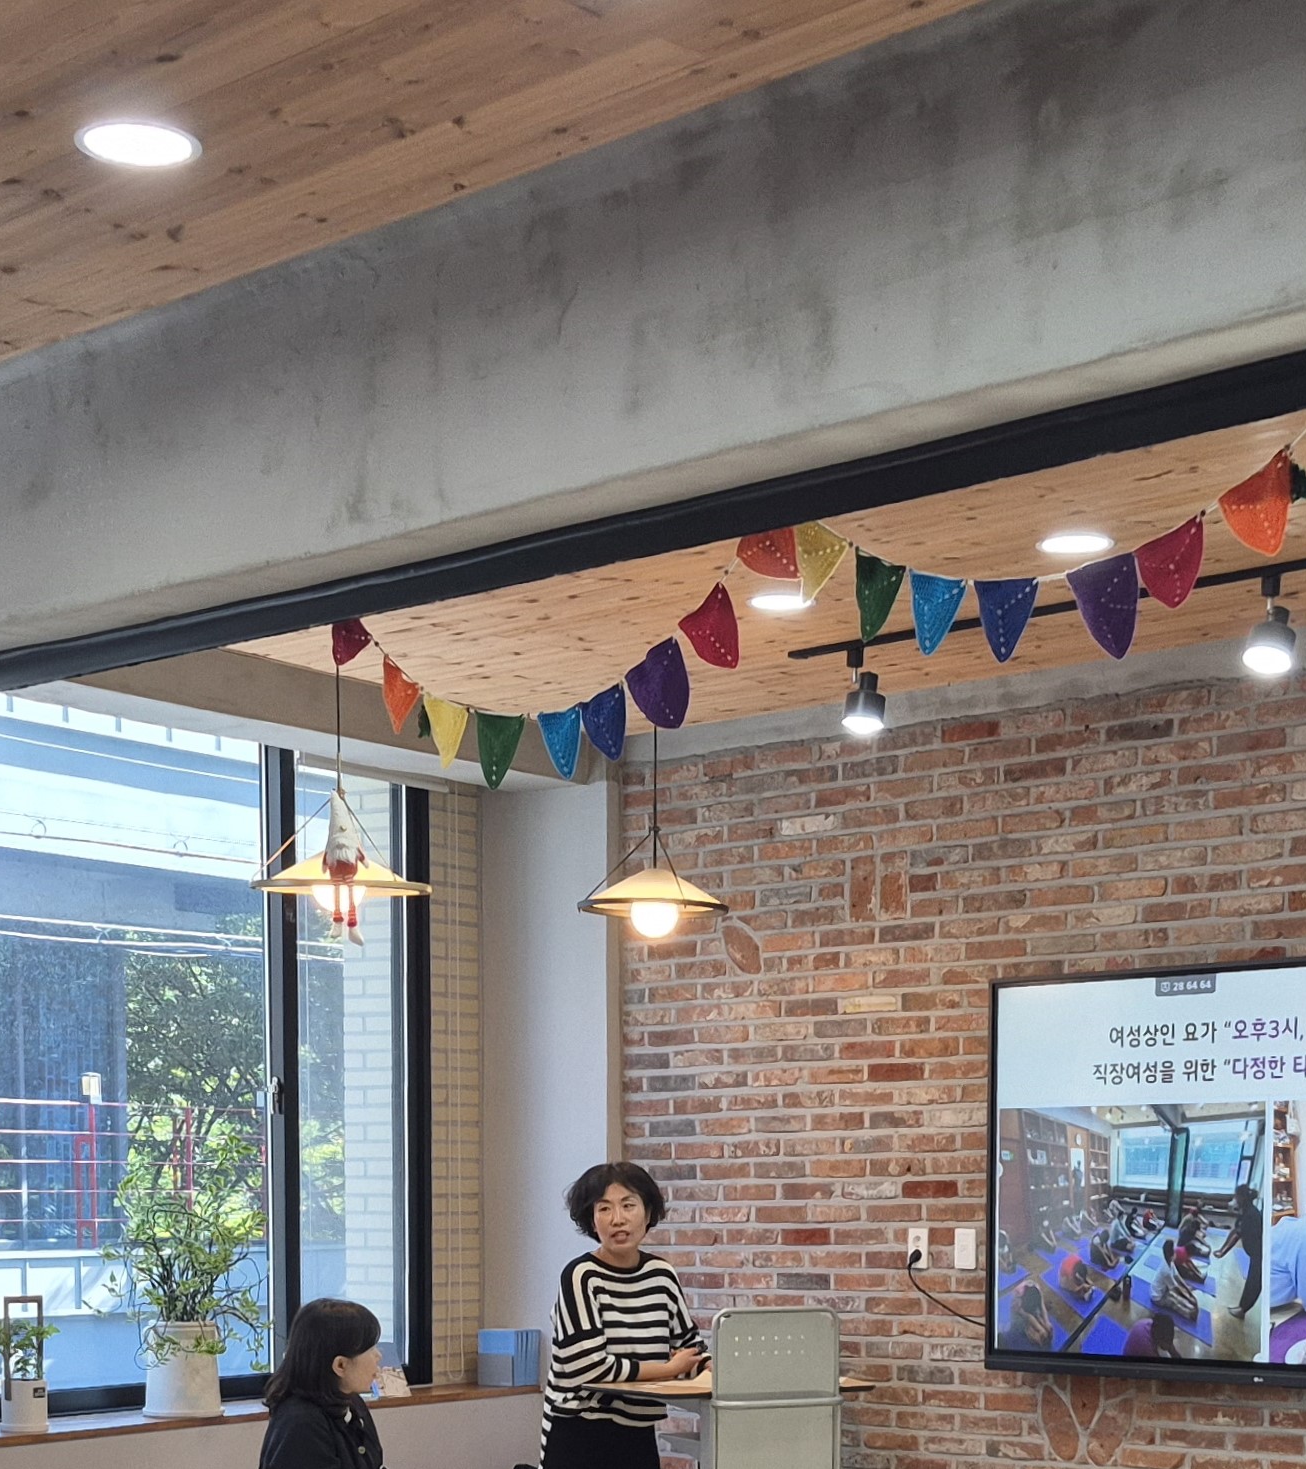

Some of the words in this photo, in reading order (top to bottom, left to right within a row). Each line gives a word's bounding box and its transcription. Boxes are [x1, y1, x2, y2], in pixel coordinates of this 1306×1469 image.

[1109, 1022, 1176, 1048] 여성상인
[1182, 1021, 1218, 1044] 요가
[1092, 1059, 1176, 1086] 직장여성을
[1182, 1058, 1217, 1083] 위한
